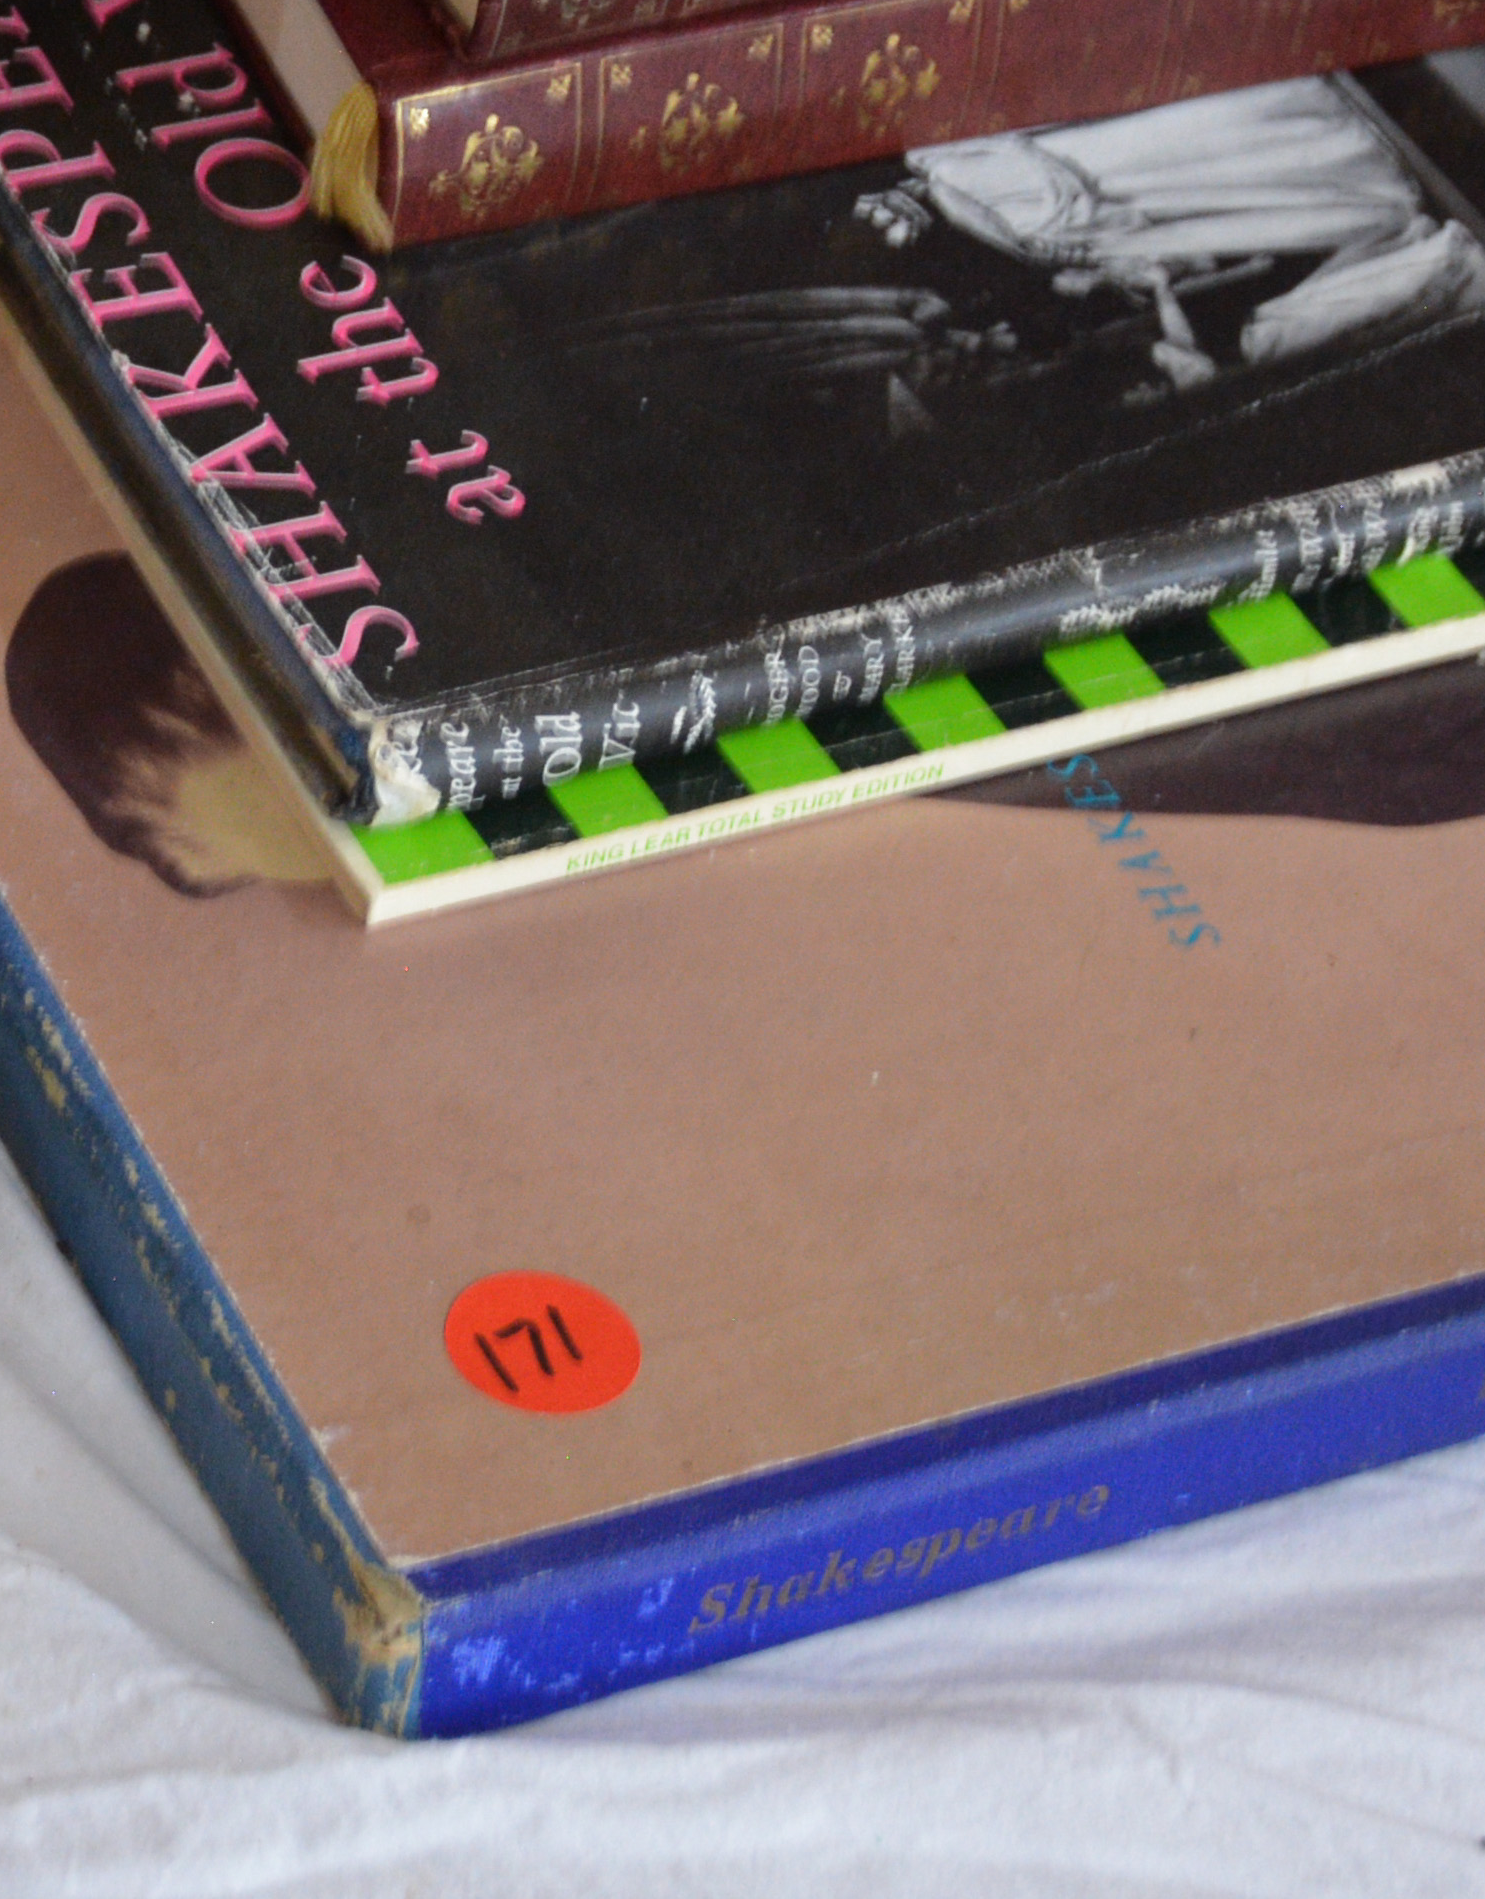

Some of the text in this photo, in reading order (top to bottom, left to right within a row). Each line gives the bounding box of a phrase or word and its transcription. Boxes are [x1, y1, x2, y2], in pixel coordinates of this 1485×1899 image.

[114, 42, 315, 229] Old
[296, 254, 440, 407] the
[405, 430, 526, 524] at
[492, 724, 524, 769] the
[534, 711, 584, 787] Old
[597, 693, 641, 772] Vic
[565, 760, 946, 875] KING LEAR TOTAL STUDY EDITION
[474, 1303, 585, 1394] 171
[685, 1480, 1112, 1640] Shakespeare
